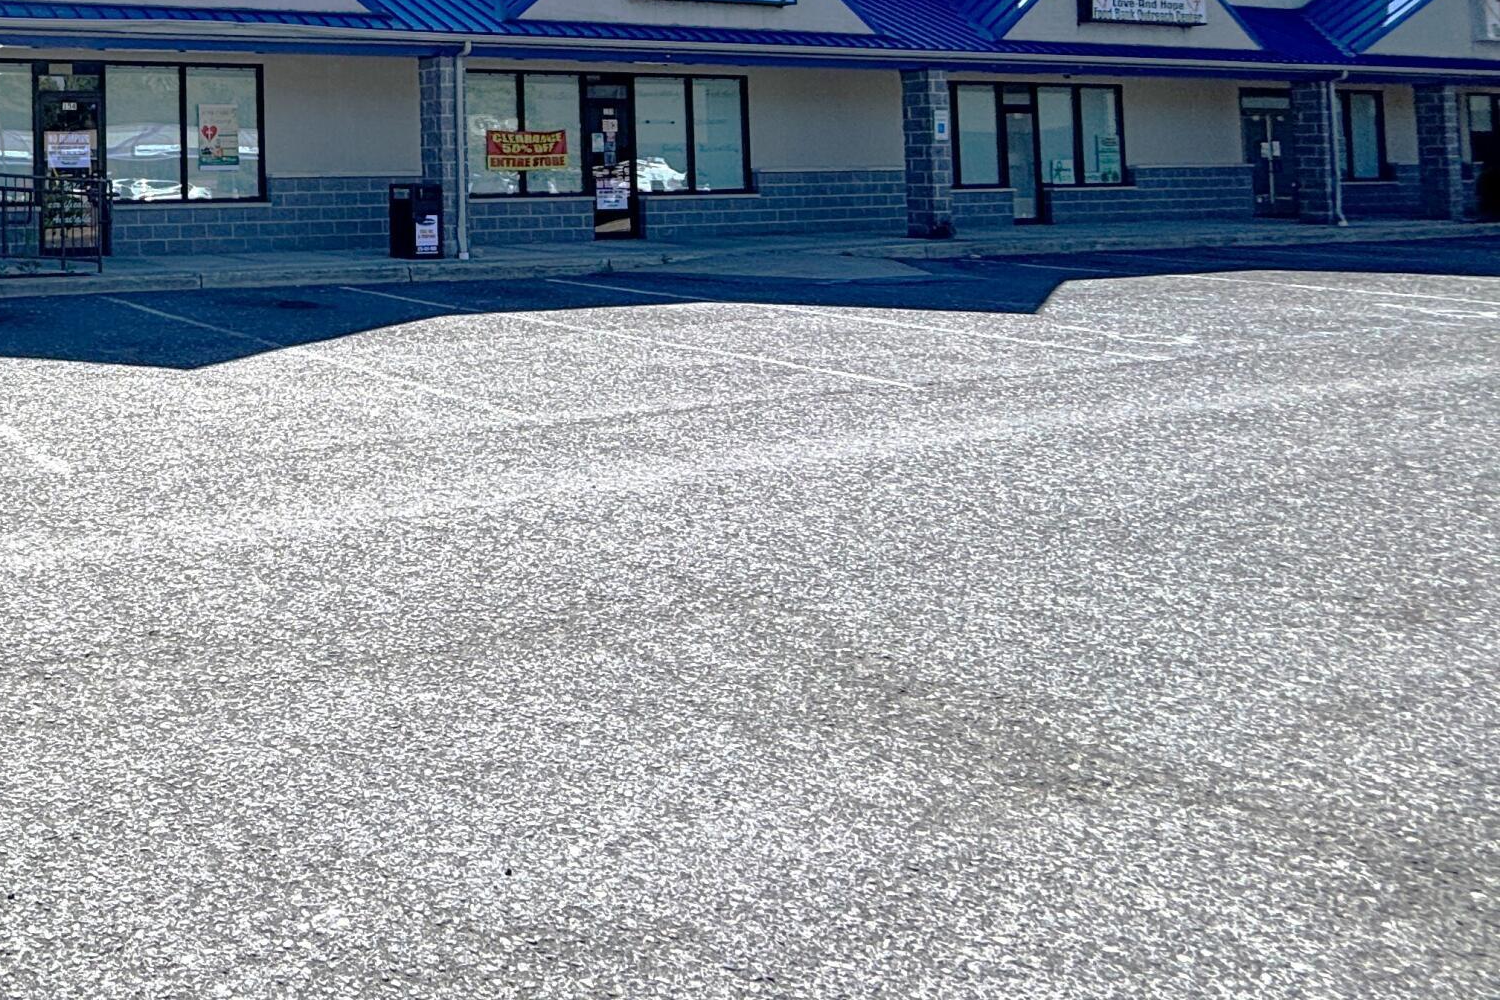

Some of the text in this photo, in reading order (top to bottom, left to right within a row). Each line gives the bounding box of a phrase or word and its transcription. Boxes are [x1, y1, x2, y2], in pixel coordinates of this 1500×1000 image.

[1161, 0, 1184, 10] Hope
[492, 133, 561, 143] CLEARANCE
[502, 142, 554, 153] 50% OFF
[490, 156, 565, 168] ENTIRE STORE
